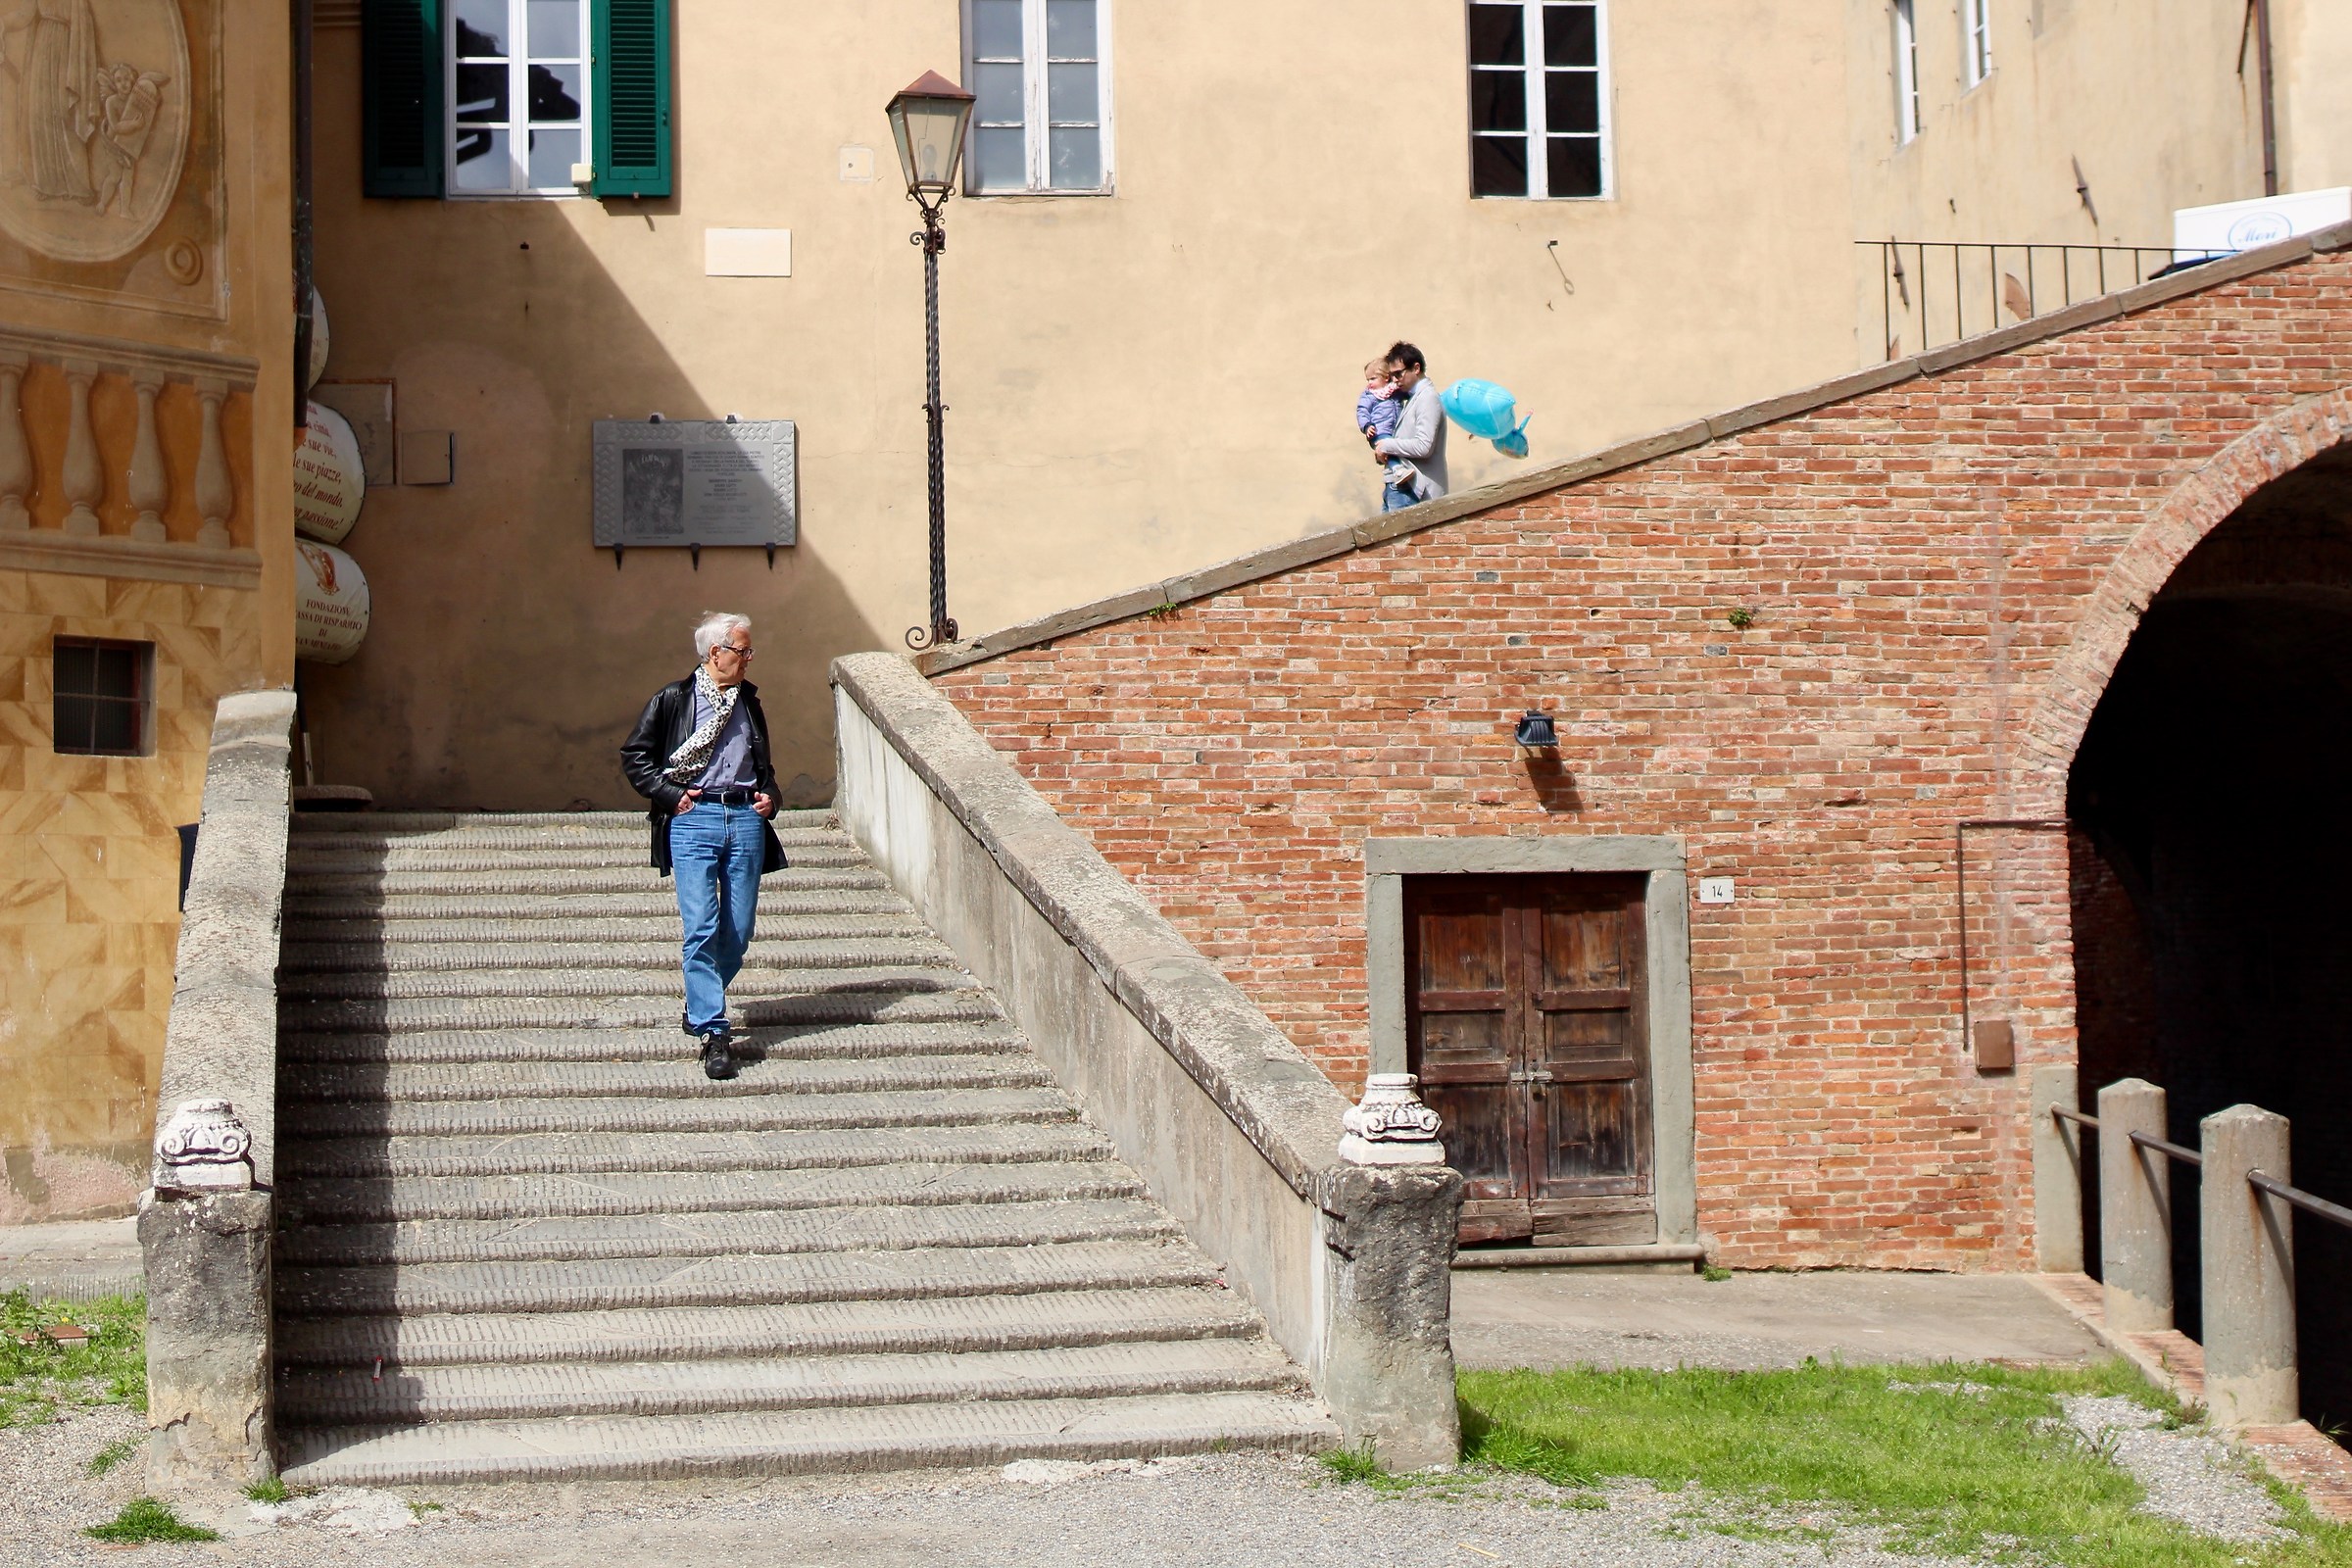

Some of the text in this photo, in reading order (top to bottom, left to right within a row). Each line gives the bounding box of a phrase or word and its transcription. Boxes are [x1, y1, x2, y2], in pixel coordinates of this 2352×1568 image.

[308, 438, 321, 453] sue
[303, 459, 315, 473] sue
[316, 462, 342, 484] piazze,
[302, 481, 317, 498] del
[307, 599, 350, 615] FONDAZIONE
[296, 611, 363, 630] ASSA DI RISPARMIO
[319, 628, 327, 637] DI
[1712, 885, 1723, 898] 14
